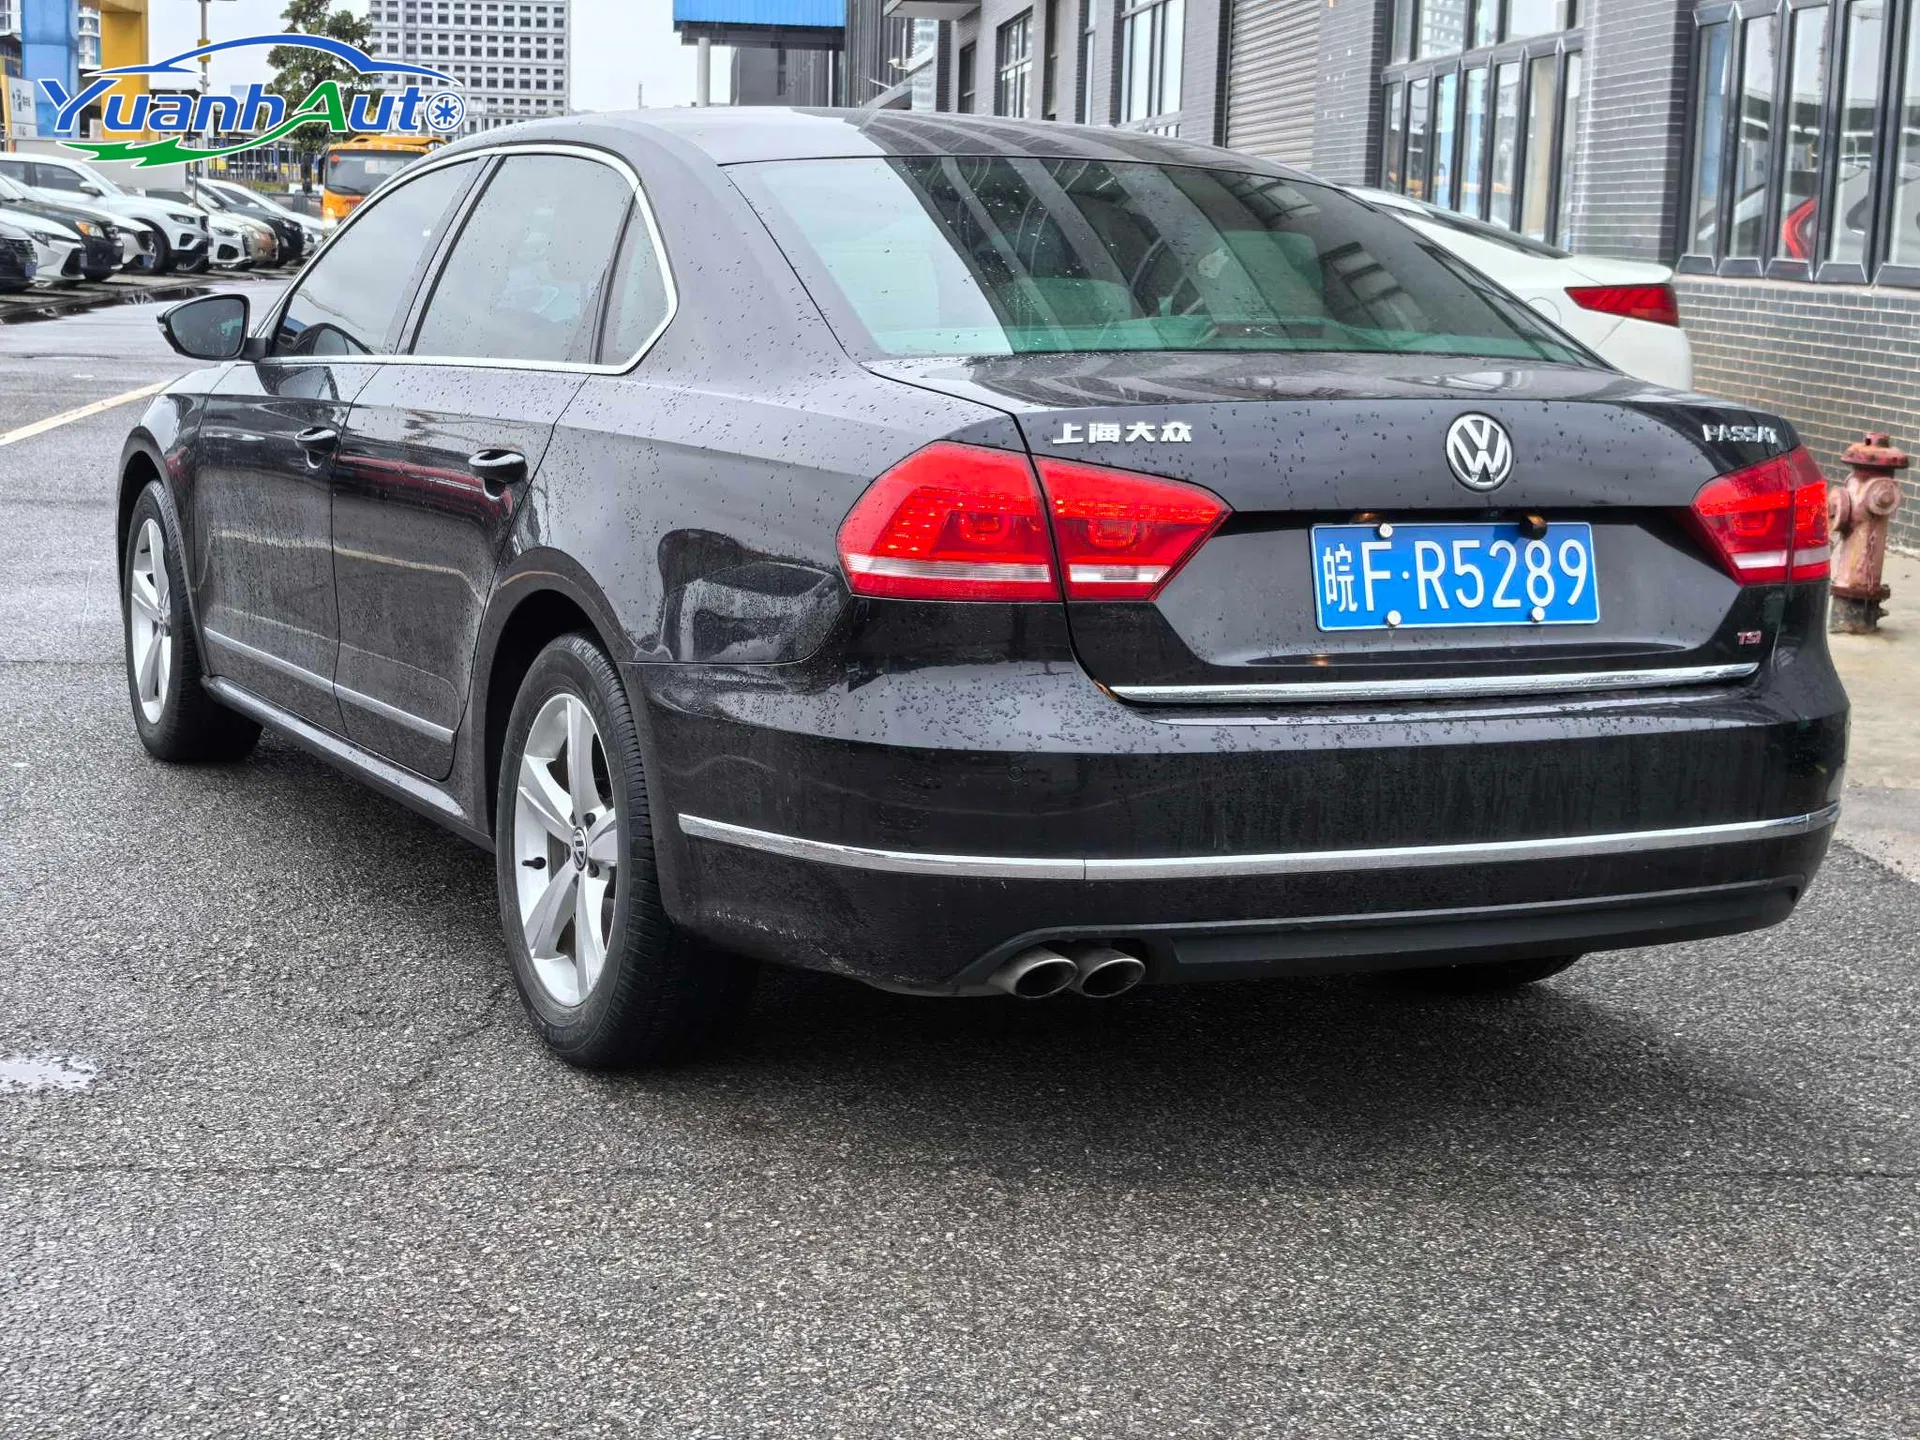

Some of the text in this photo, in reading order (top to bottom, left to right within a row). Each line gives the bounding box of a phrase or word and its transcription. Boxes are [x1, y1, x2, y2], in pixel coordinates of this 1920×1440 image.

[1052, 421, 1193, 444] 上海大众
[1446, 414, 1512, 487] VW
[1702, 424, 1778, 443] PASSAT
[1322, 539, 1588, 613] 皖F·R5289
